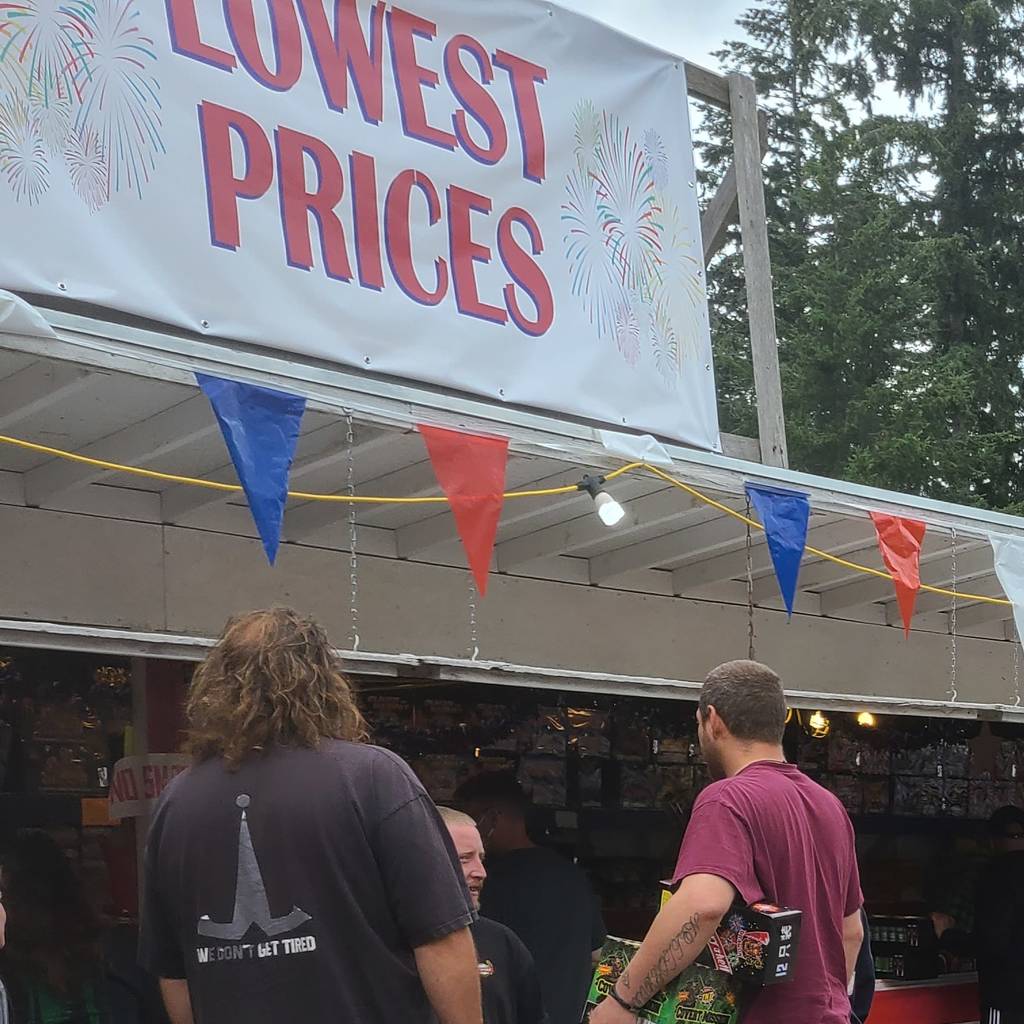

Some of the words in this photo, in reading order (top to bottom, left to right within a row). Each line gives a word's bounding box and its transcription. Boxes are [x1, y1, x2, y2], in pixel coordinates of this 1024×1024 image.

[197, 99, 555, 338] PRICES
[196, 946, 215, 963] WE
[257, 940, 280, 958] GET
[281, 935, 317, 955] TIRED
